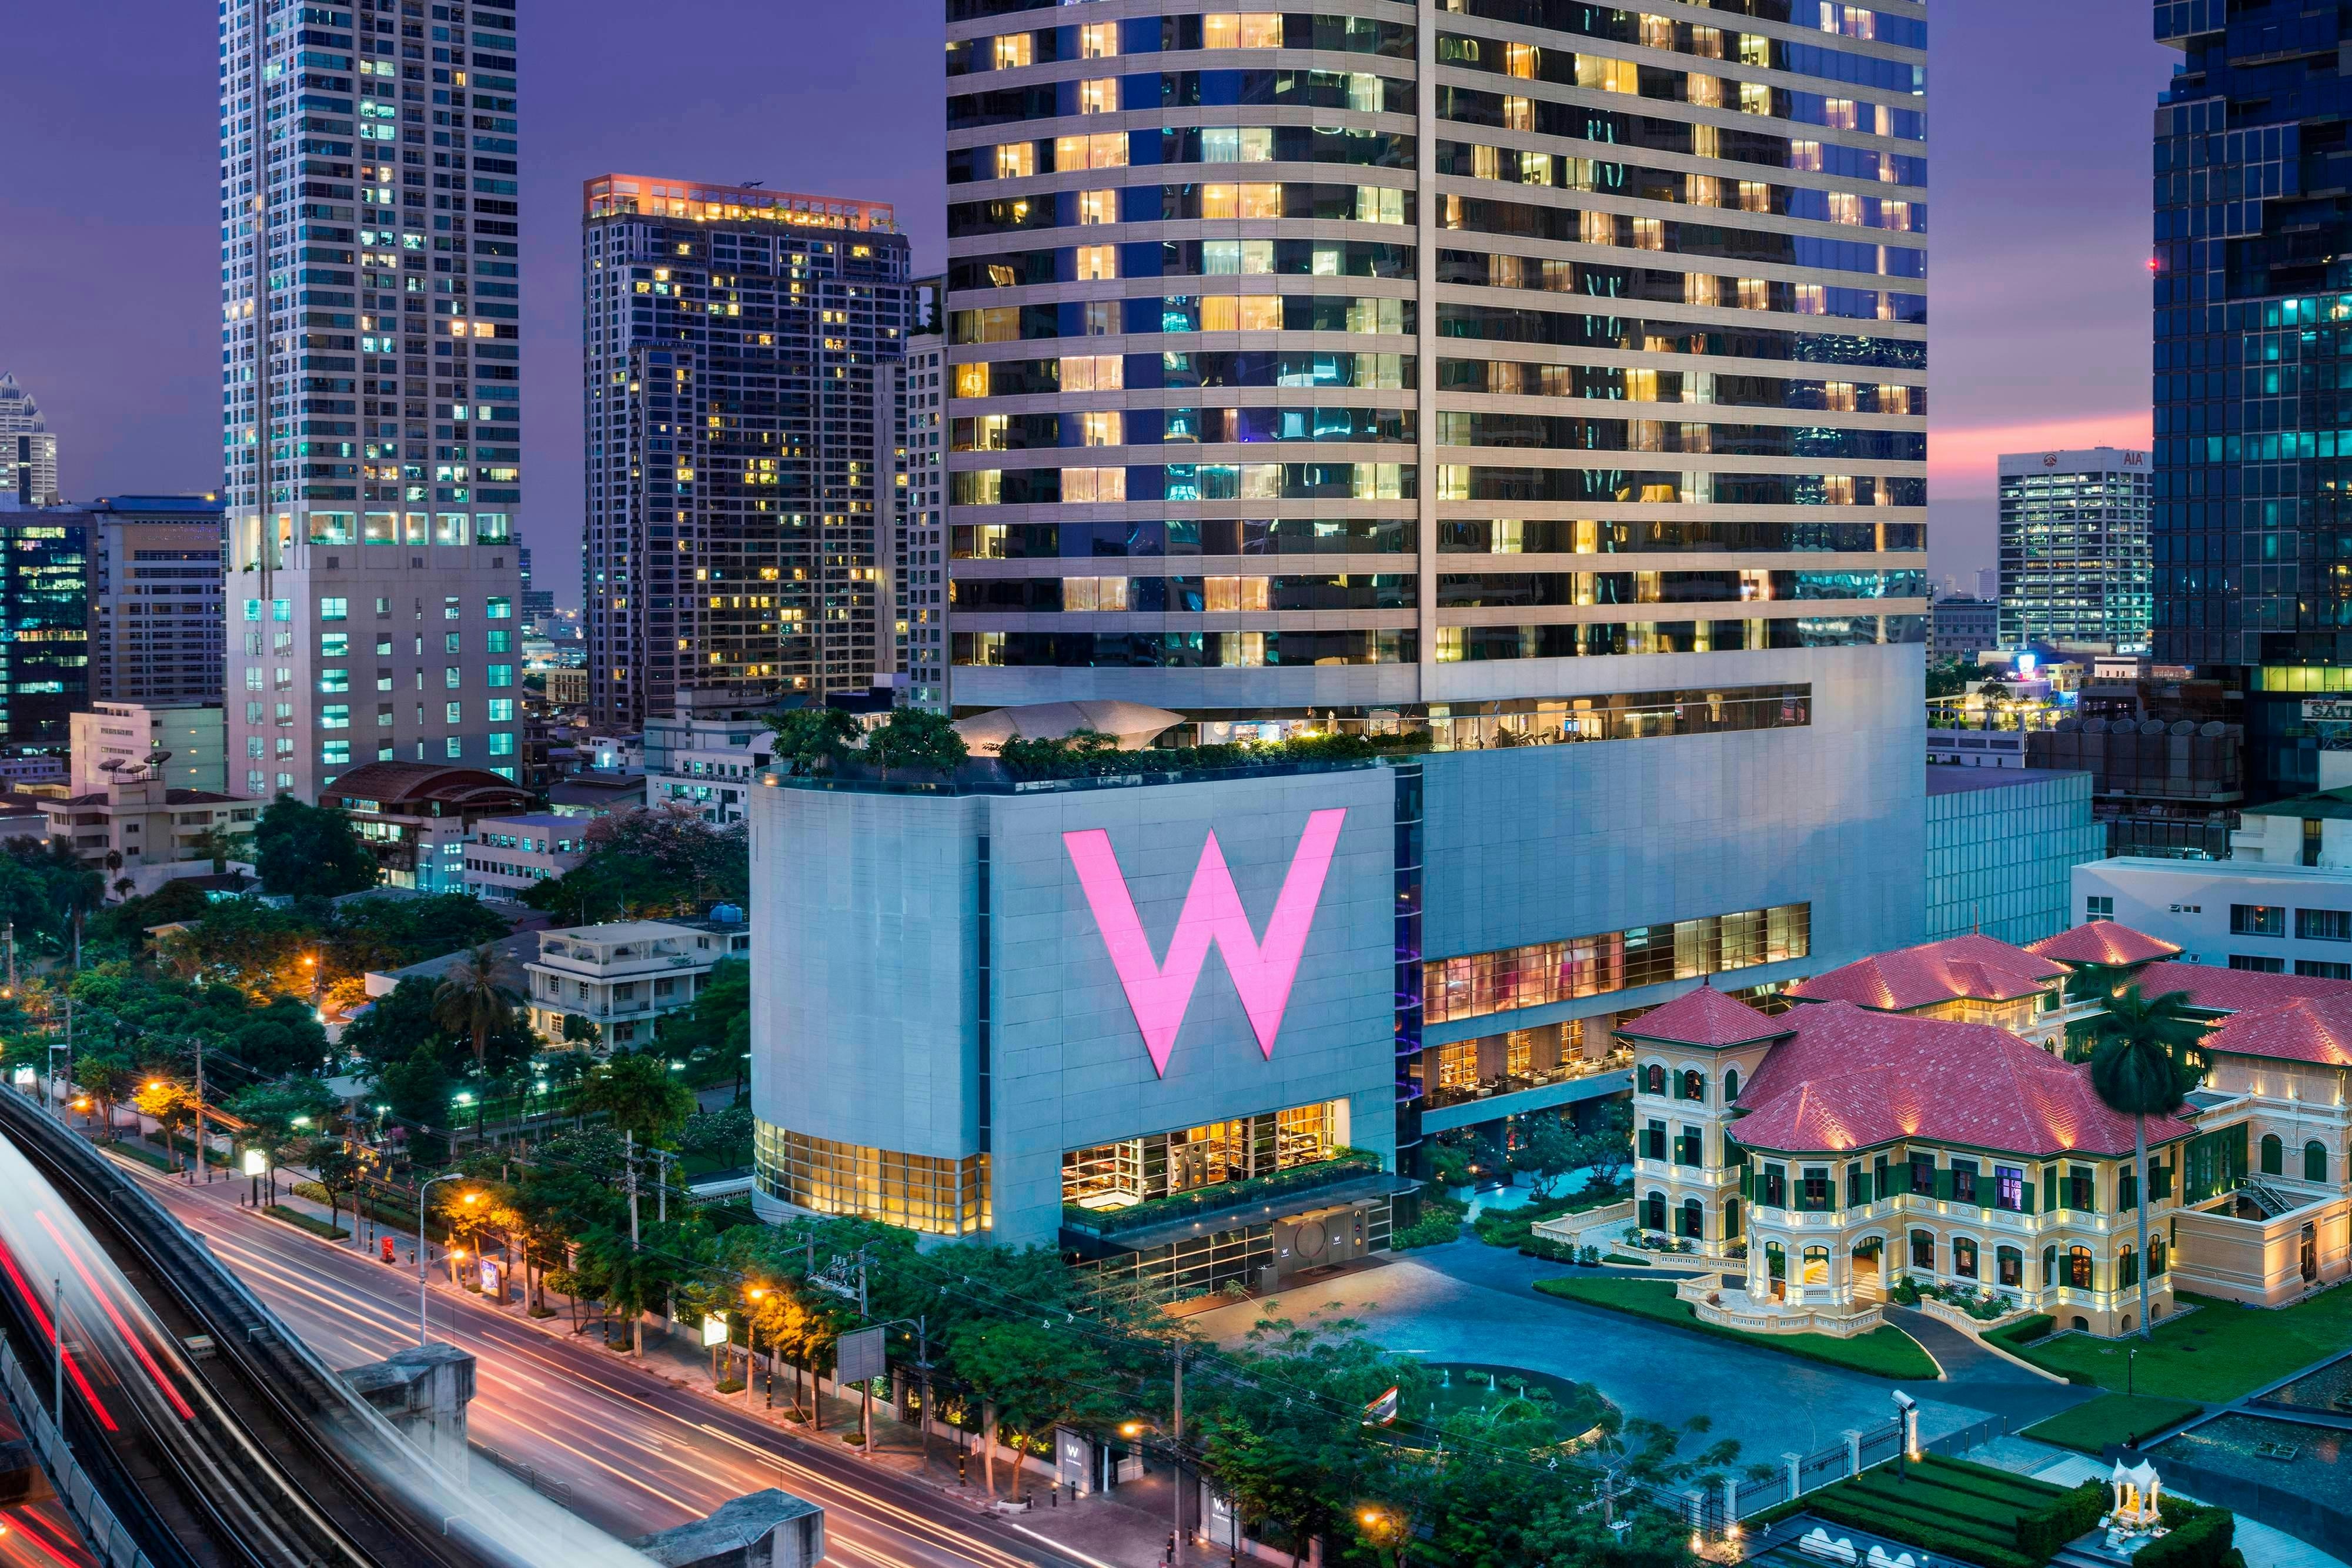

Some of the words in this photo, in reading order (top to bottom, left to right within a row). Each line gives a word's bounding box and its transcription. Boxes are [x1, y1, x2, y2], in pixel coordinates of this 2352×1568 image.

[2123, 452, 2143, 465] AIA
[1061, 807, 1349, 1080] W
[1067, 1444, 1079, 1458] W
